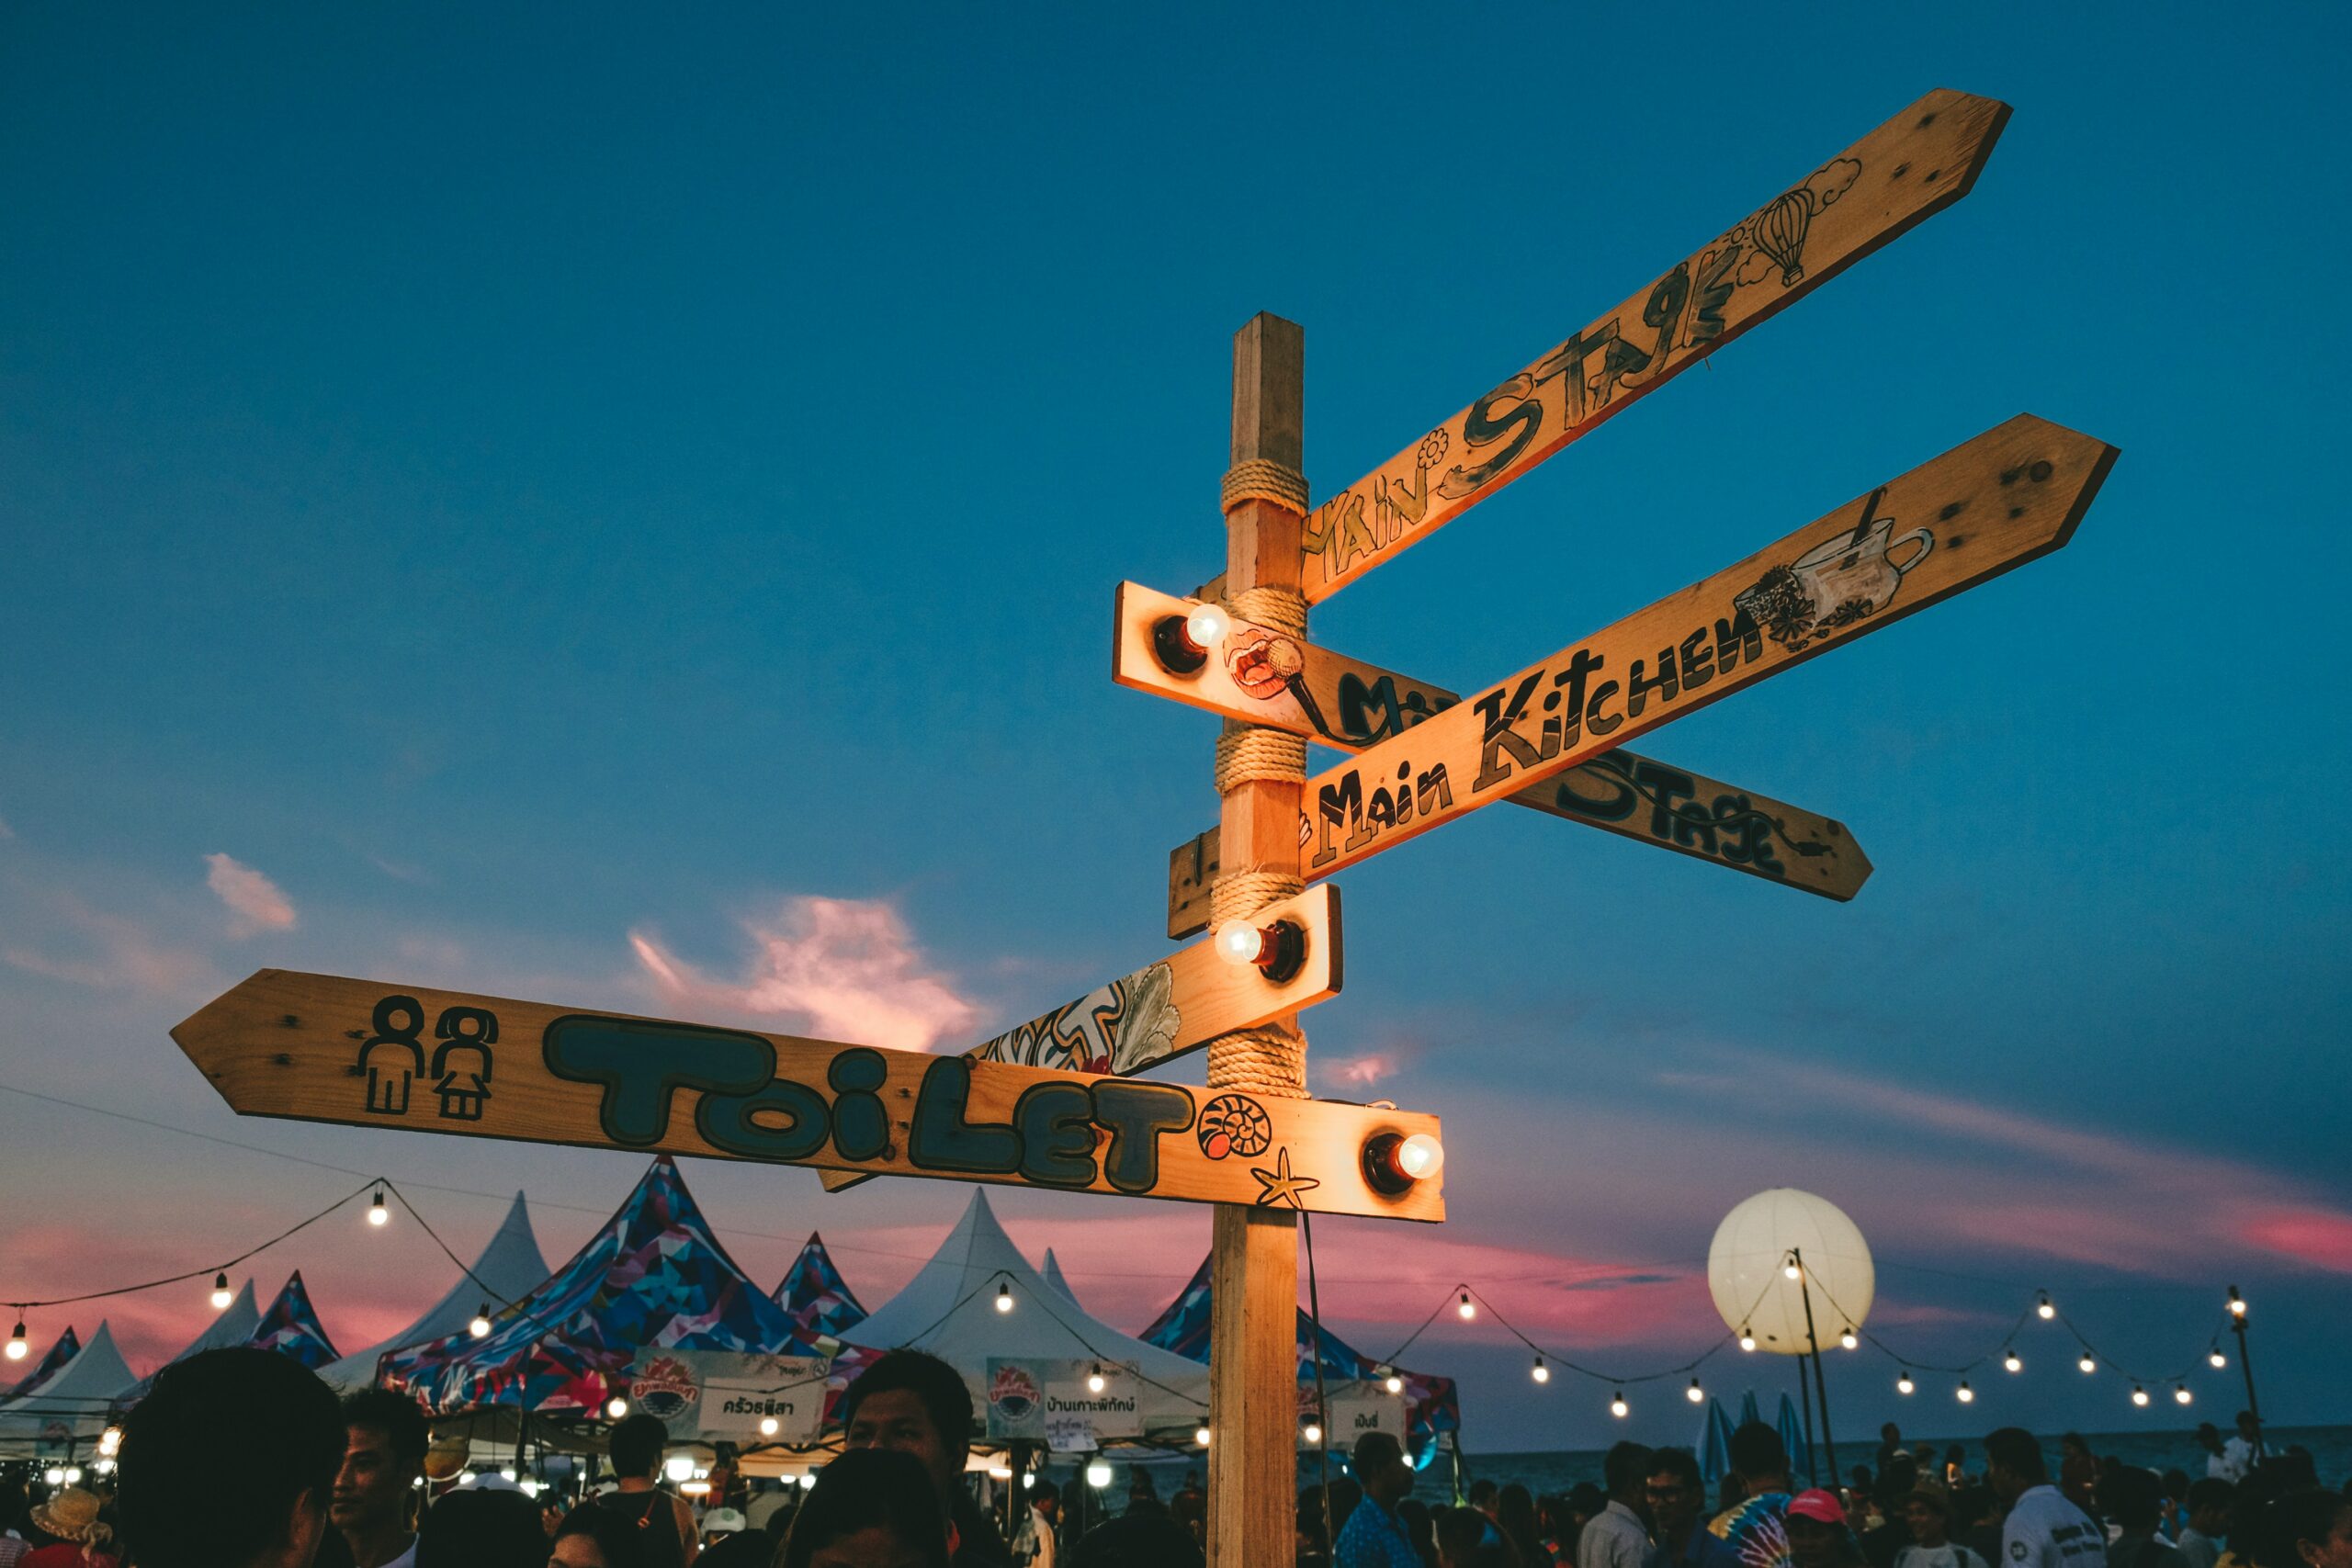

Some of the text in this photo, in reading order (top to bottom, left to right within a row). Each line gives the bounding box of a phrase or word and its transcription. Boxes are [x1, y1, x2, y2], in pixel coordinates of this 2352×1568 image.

[1046, 1395, 1136, 1413] บ้านเกาะพิทักษ์
